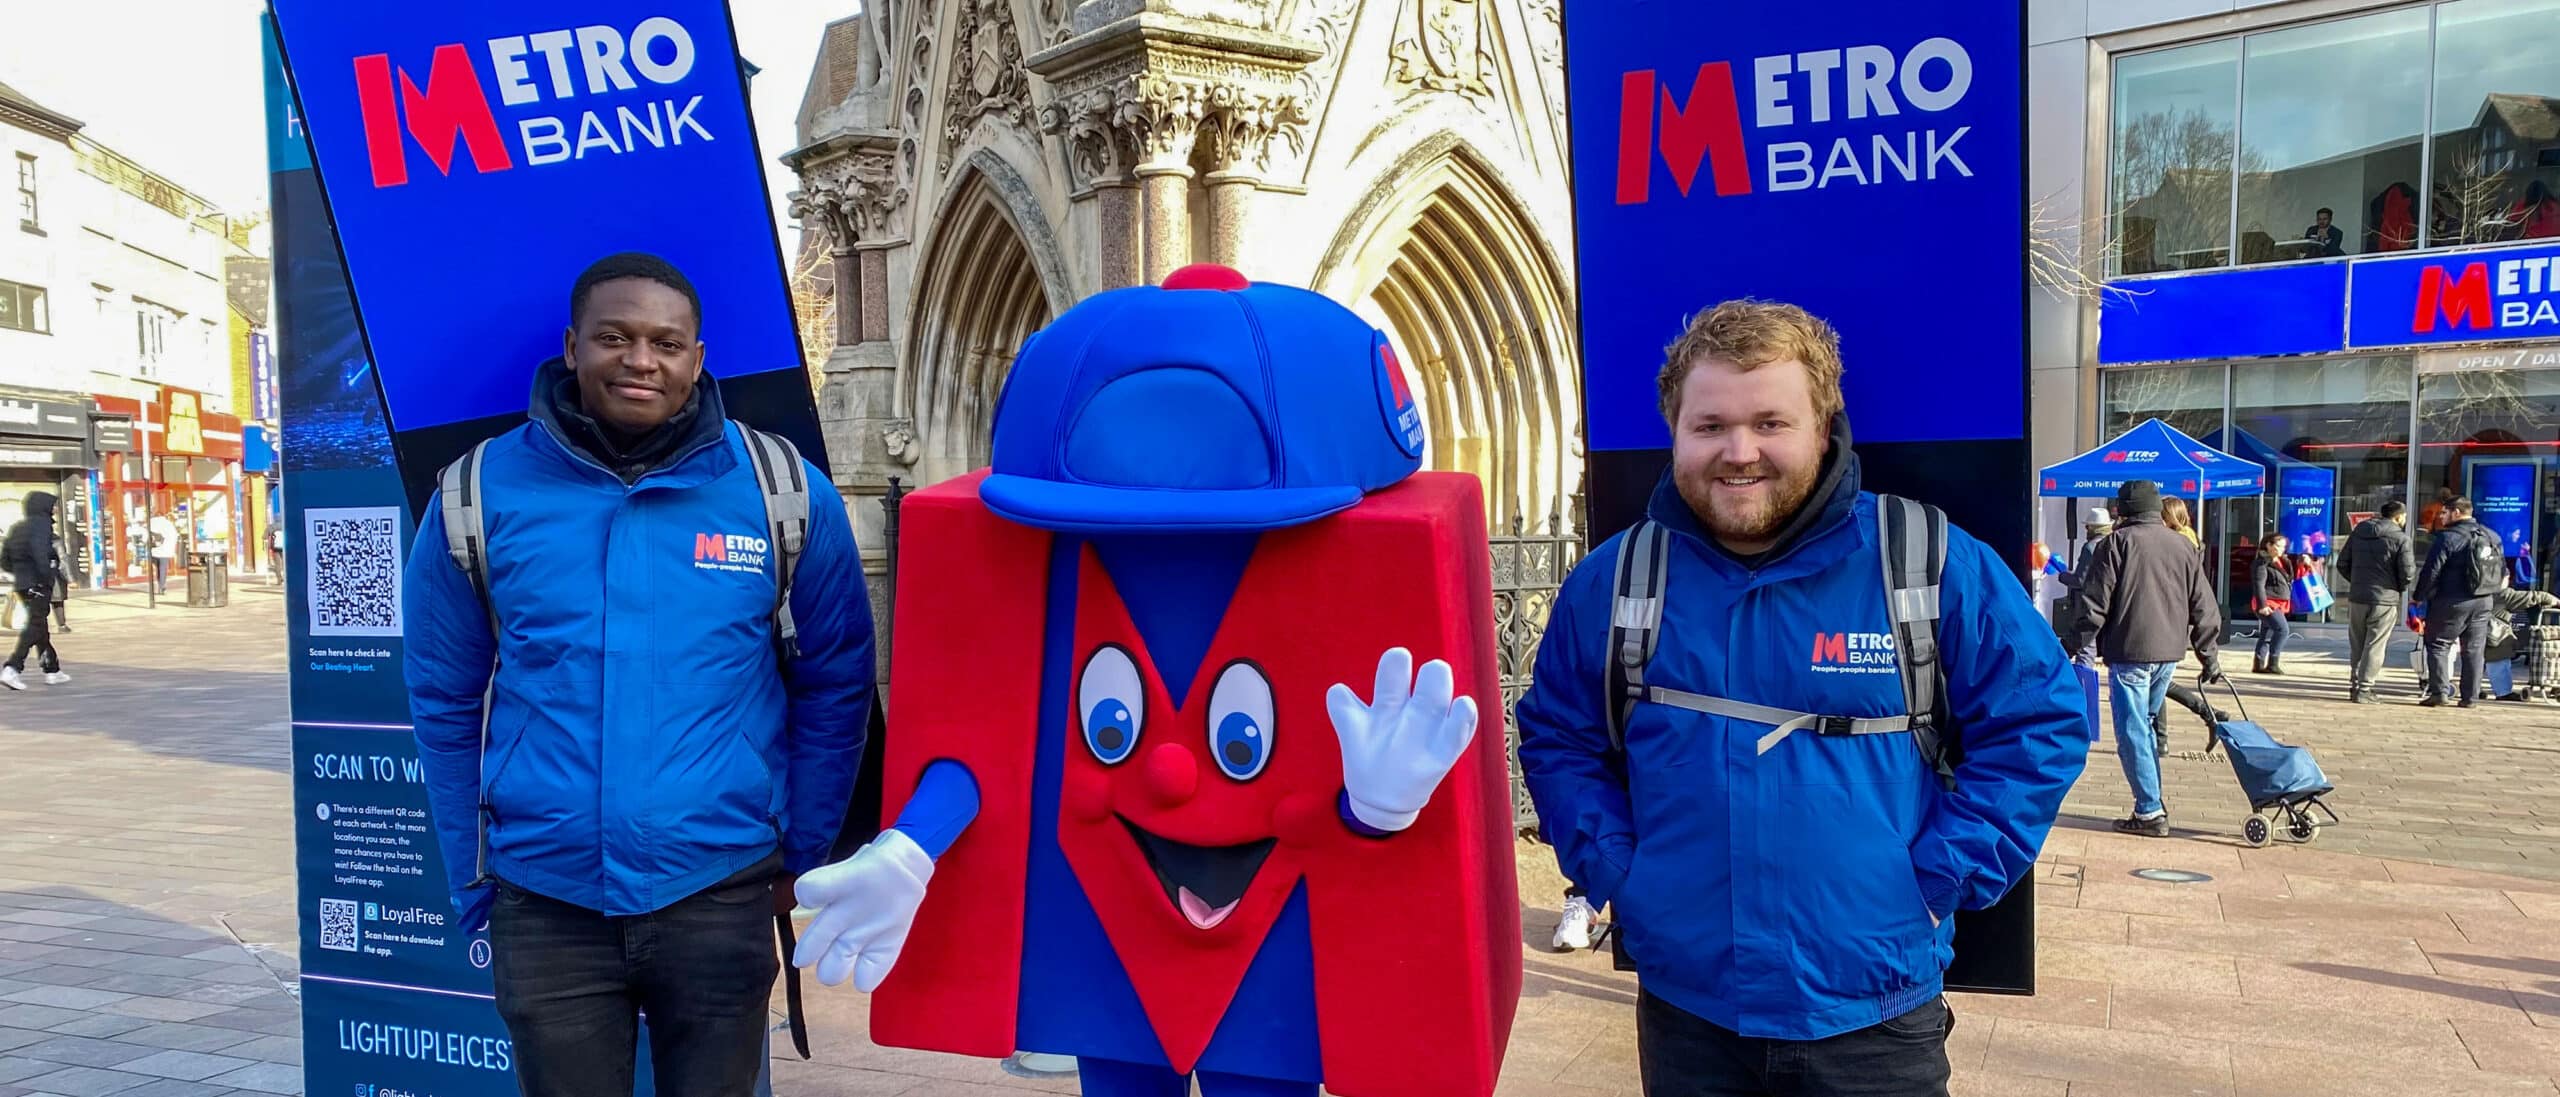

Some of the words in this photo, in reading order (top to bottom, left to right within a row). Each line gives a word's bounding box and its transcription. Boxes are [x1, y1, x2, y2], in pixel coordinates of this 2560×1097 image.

[353, 17, 695, 188] METRO
[1616, 37, 1973, 205] METRO
[518, 95, 714, 166] BANK
[1767, 126, 1974, 192] BANK
[2501, 300, 2560, 327] BA
[2458, 356, 2505, 369] OPEN
[2513, 349, 2528, 366] 7
[2102, 451, 2160, 463] METRO
[2073, 481, 2092, 489] JOIN
[2094, 481, 2111, 489] THE
[2289, 497, 2308, 505] Join
[2310, 497, 2325, 505] the
[2297, 507, 2322, 516] party
[695, 533, 768, 561] METRO
[728, 551, 766, 567] BANK
[309, 647, 327, 657] Scan
[328, 648, 344, 657] here
[345, 649, 353, 657] to
[354, 648, 375, 657] check
[376, 648, 391, 658] into
[1812, 632, 1895, 664] METRO
[1849, 651, 1896, 665] BANK
[310, 662, 323, 671] Our
[325, 662, 352, 673] Beating
[314, 753, 364, 780] SCAN
[369, 755, 394, 782] TO
[401, 757, 425, 784] WI
[333, 803, 358, 814] There's
[365, 806, 395, 816] different
[395, 807, 407, 817] QR
[407, 809, 426, 818] code
[333, 819, 341, 827] at
[342, 819, 360, 828] each
[360, 821, 388, 830] artwork
[394, 822, 407, 831] the
[407, 824, 427, 833] more
[333, 831, 365, 842] locations
[365, 835, 378, 844] you
[398, 836, 410, 846] the
[334, 847, 353, 856] more
[353, 848, 382, 858] chances
[382, 851, 396, 861] you
[396, 850, 414, 861] have
[415, 852, 423, 862] to
[350, 861, 372, 872] Follow
[372, 863, 385, 873] the
[385, 864, 400, 874] trail
[400, 866, 410, 875] on
[411, 866, 424, 876] the
[334, 874, 368, 885] LoyalFree
[381, 904, 445, 926] LoyalFree
[364, 930, 382, 940] Scan
[383, 931, 400, 942] here
[400, 933, 409, 943] to
[409, 934, 445, 947] download
[363, 944, 376, 954] the
[376, 946, 393, 957] app.
[338, 1018, 513, 1072] LIGHTUPLEICES
